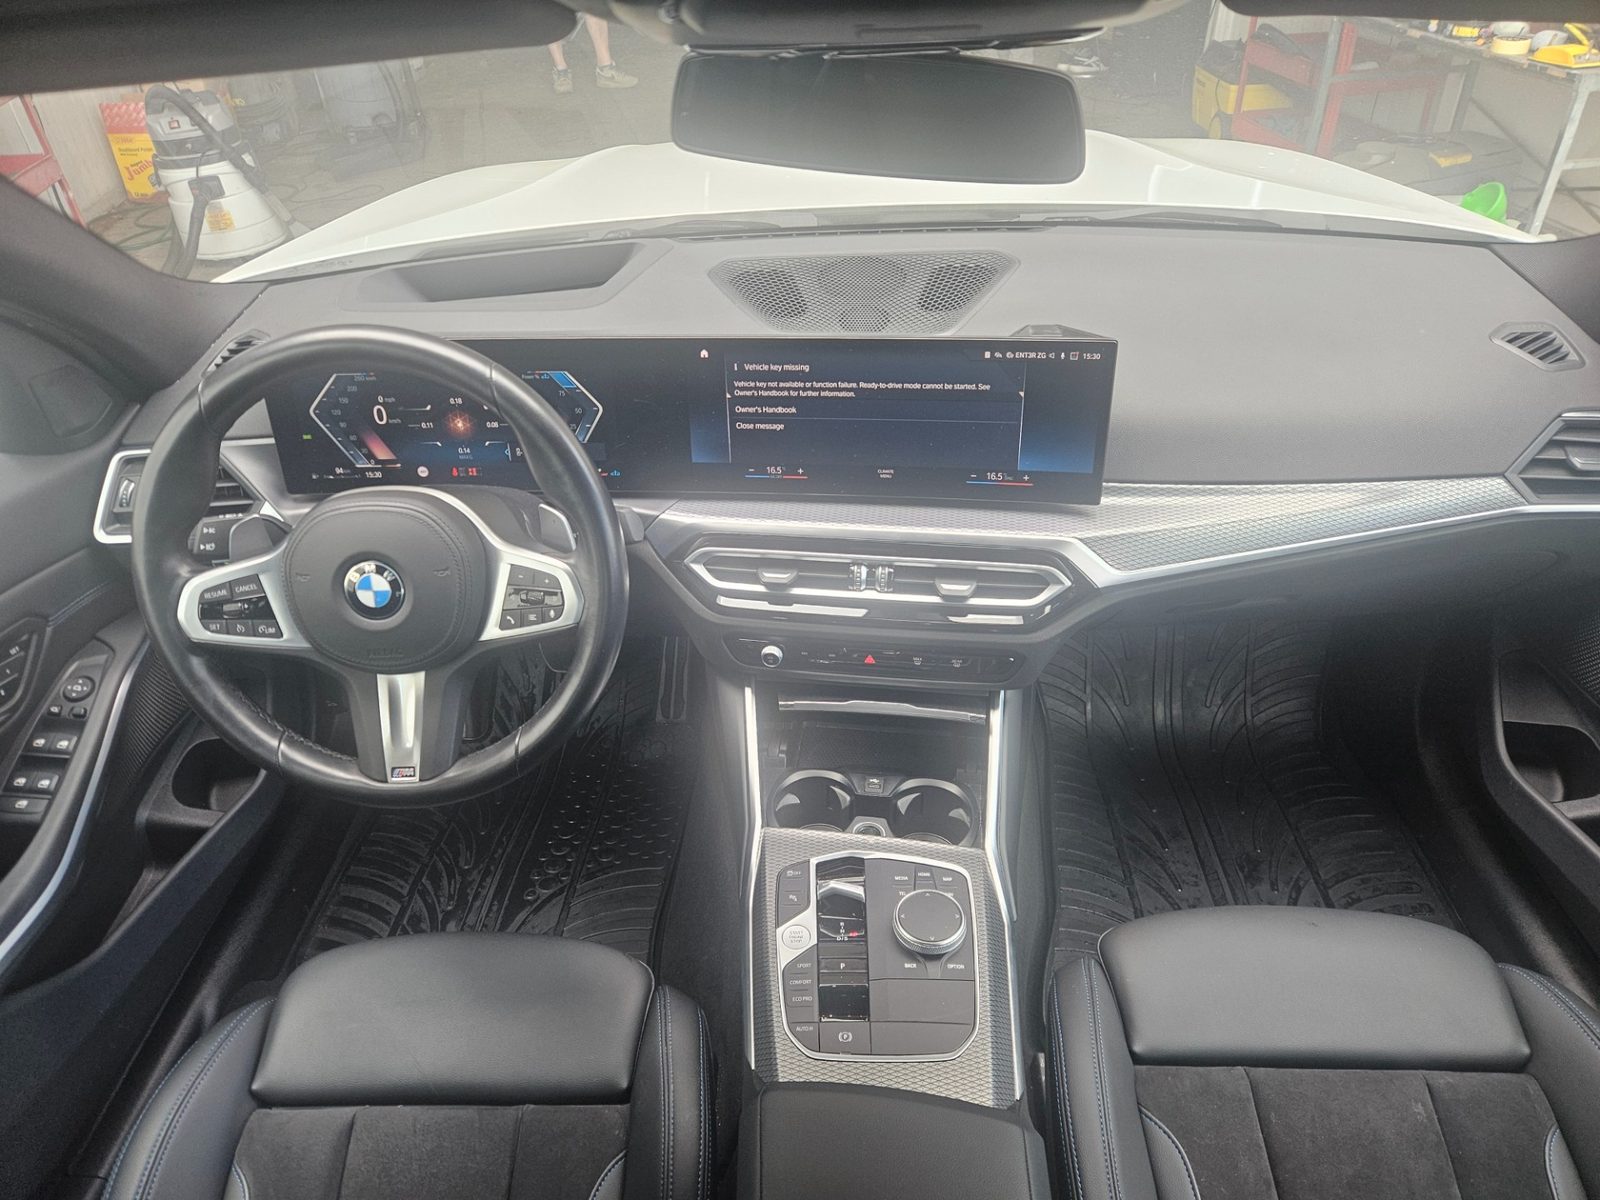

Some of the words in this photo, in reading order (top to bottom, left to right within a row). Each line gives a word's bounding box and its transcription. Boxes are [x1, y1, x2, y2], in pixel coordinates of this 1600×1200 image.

[744, 363, 769, 371] Vehicle
[770, 363, 782, 372] key
[784, 364, 810, 372] missing
[756, 380, 767, 389] key
[860, 382, 902, 390] Ready-to-drive
[735, 405, 762, 413] Owner's
[762, 406, 796, 414] Handbook
[373, 405, 387, 424] 0
[736, 422, 754, 430] Close
[755, 423, 785, 431] message
[766, 466, 782, 474] 16.5
[986, 472, 1003, 480] 16.5
[235, 584, 258, 593] CANCEL
[204, 590, 228, 599] RESUME
